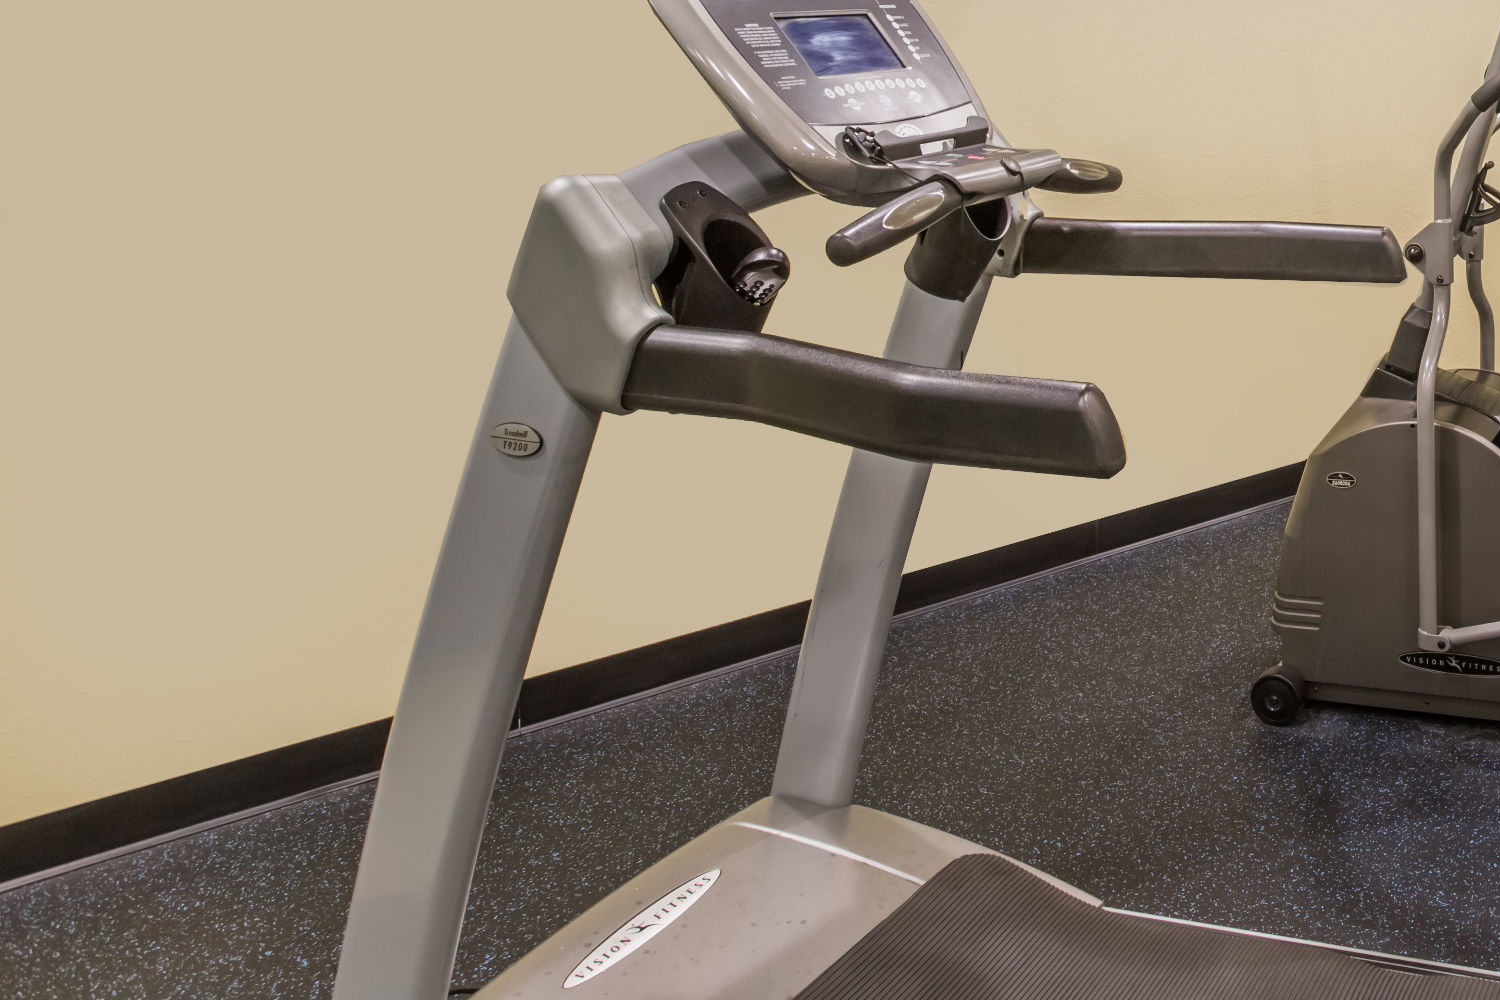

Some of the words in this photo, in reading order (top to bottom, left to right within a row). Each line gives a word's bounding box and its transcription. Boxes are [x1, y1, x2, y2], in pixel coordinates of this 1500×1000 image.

[504, 428, 528, 438] Treadmill
[503, 440, 528, 452] T9200
[1406, 656, 1445, 666] VISION
[575, 936, 632, 979] VISION
[654, 876, 712, 920] FITNESS
